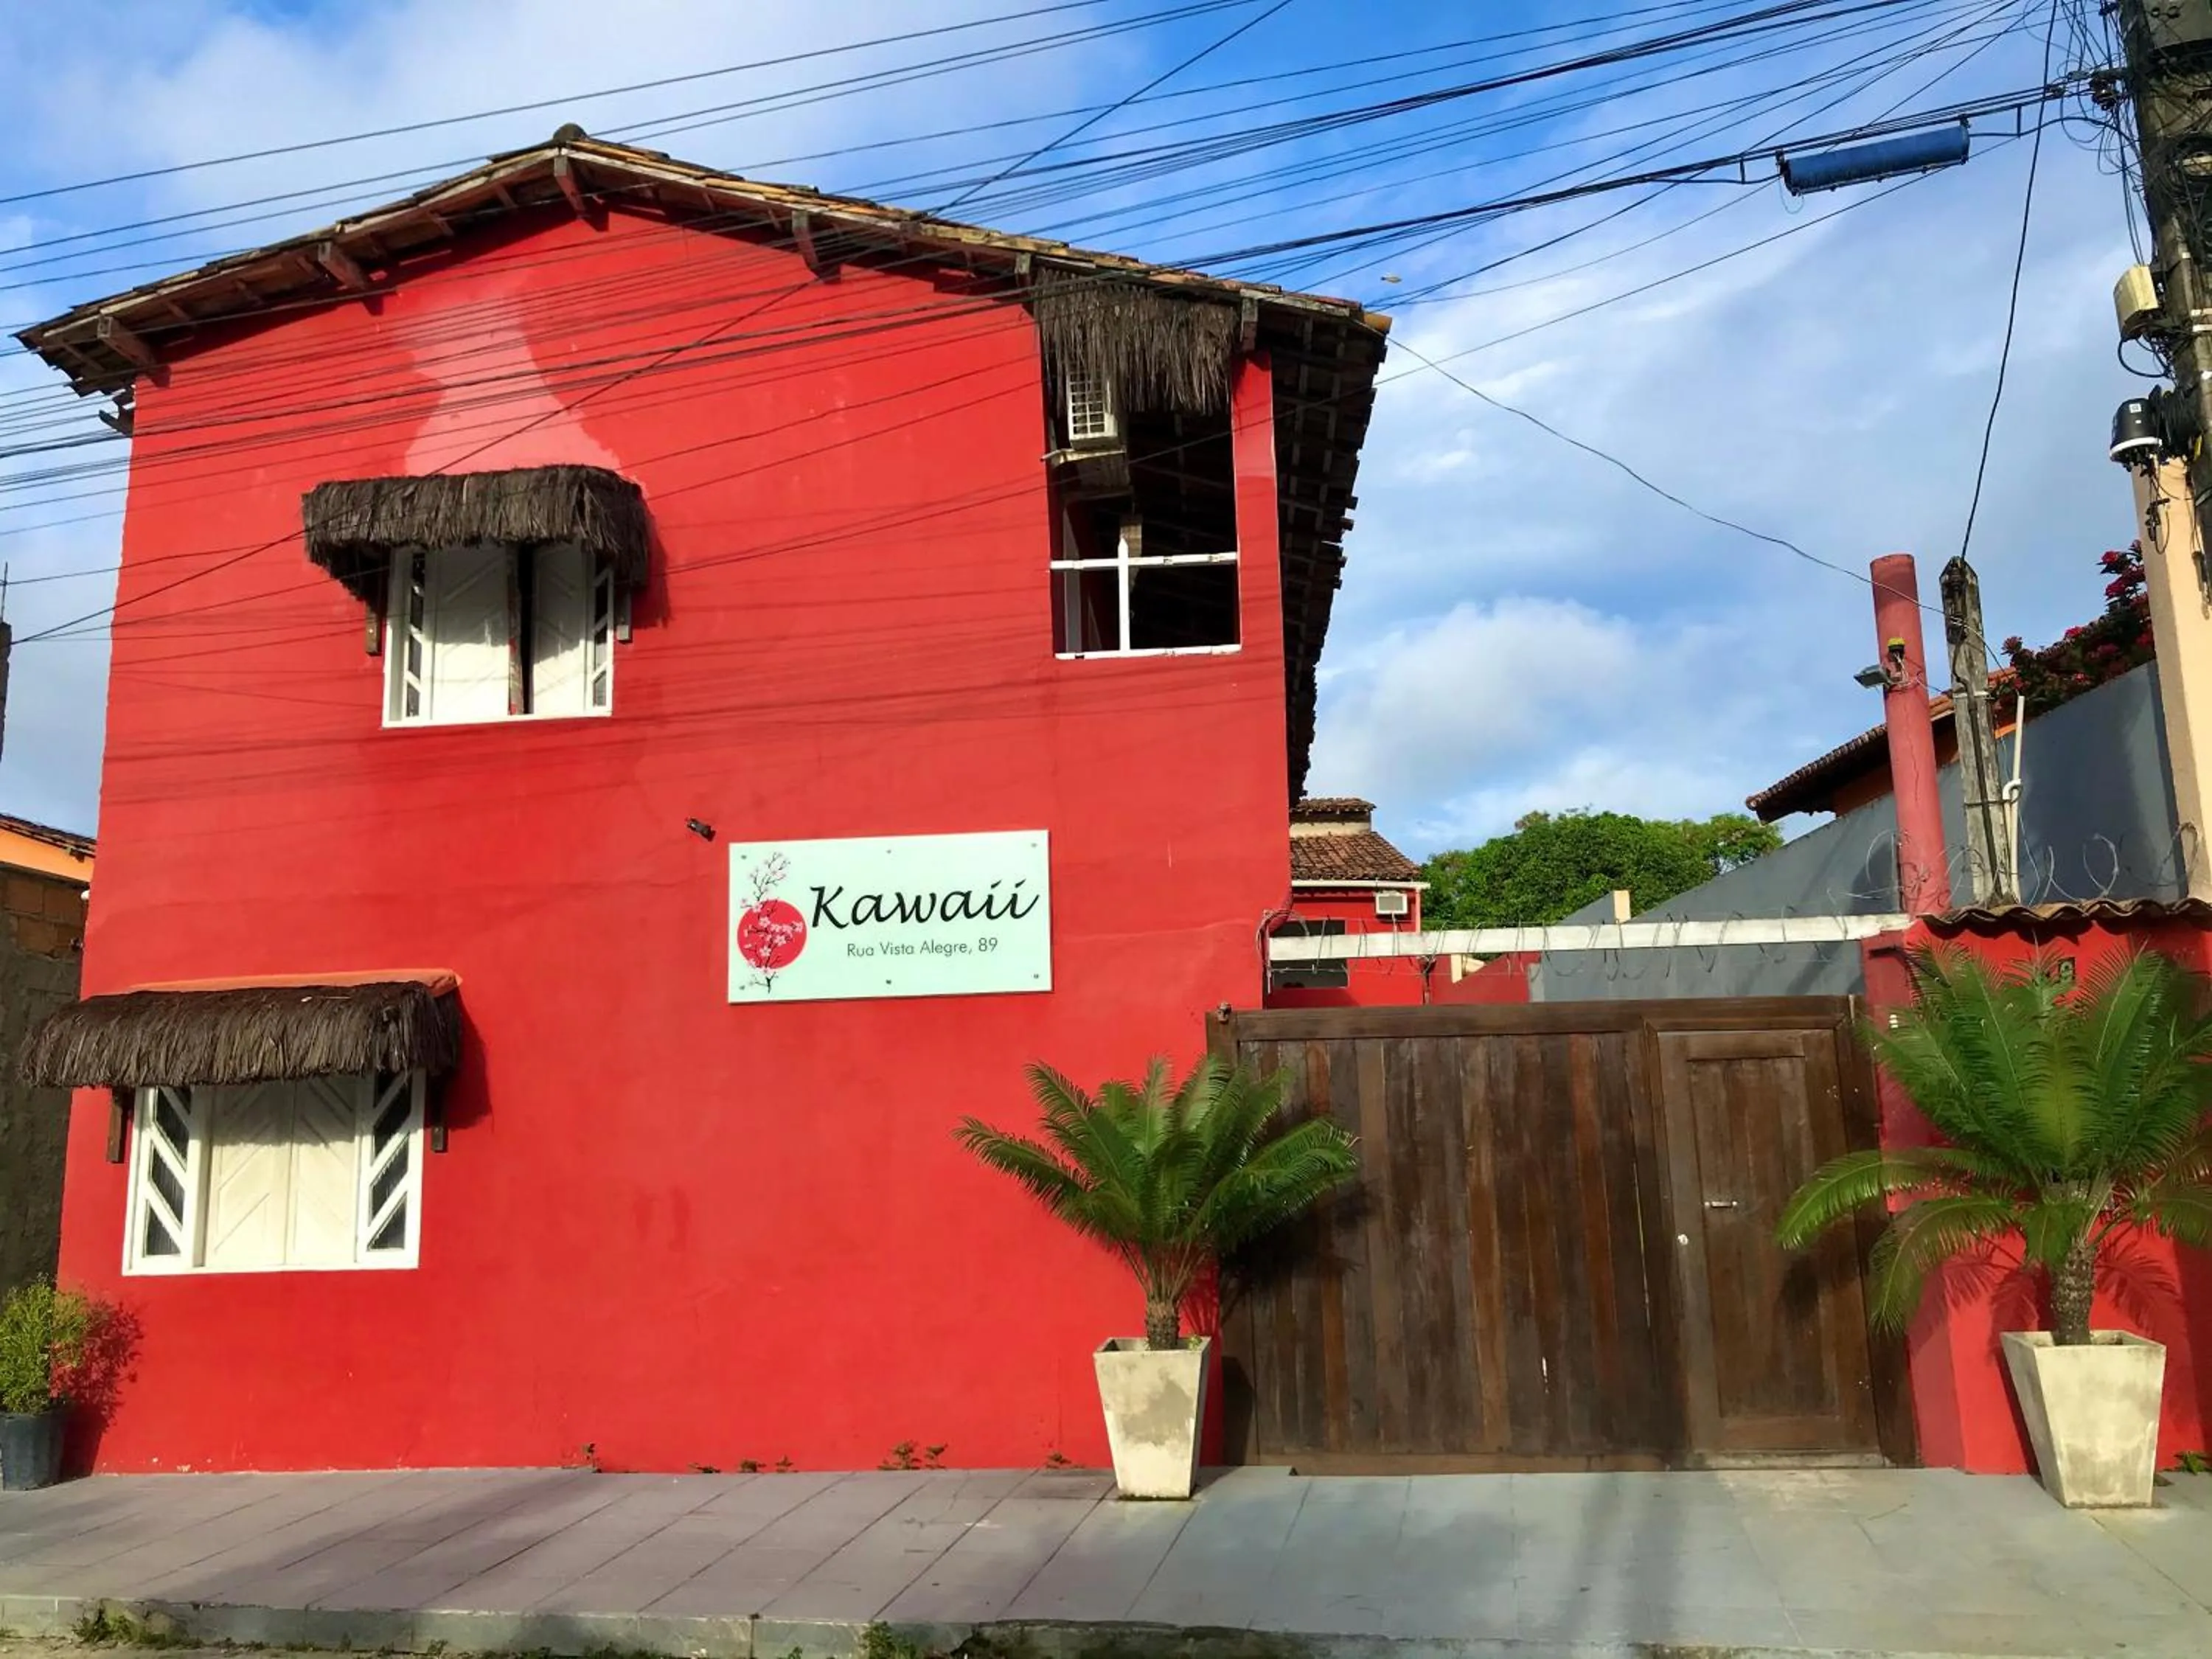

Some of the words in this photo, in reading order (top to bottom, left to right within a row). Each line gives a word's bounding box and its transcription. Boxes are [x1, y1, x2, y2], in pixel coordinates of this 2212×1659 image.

[847, 943, 874, 957] Rua
[880, 941, 914, 956] Vista
[919, 938, 973, 958] Alegre,
[978, 937, 998, 952] 89
